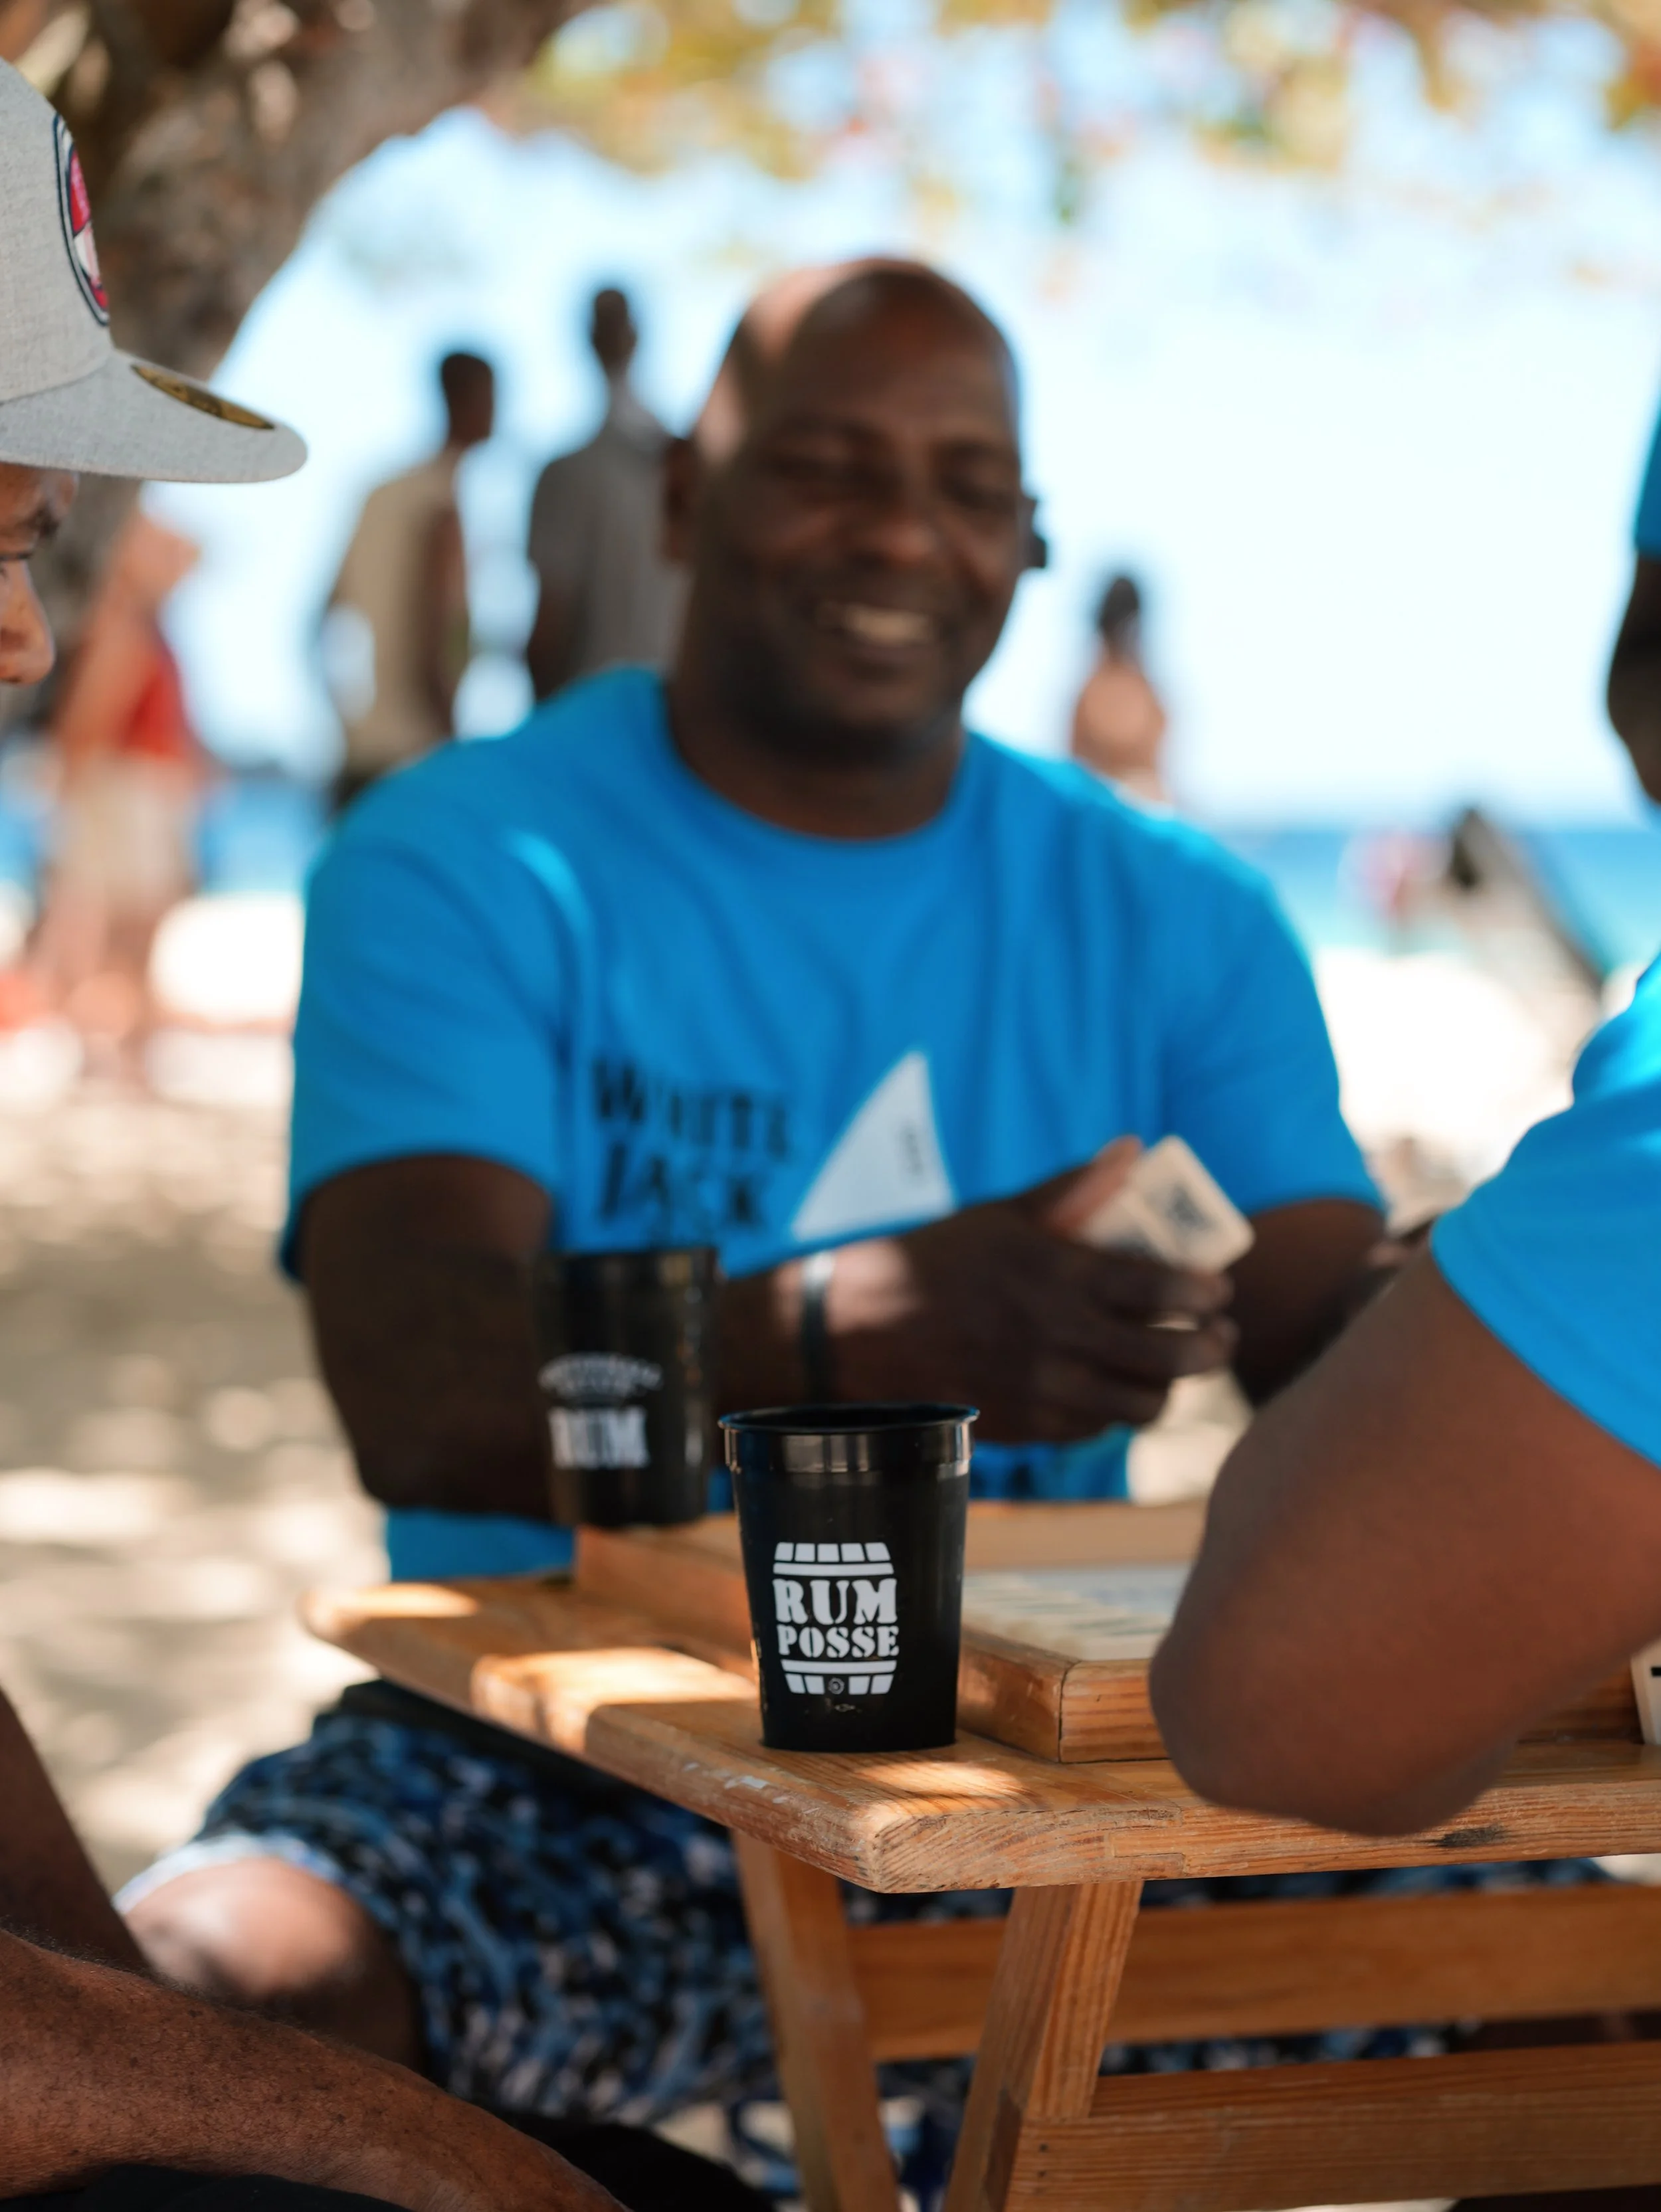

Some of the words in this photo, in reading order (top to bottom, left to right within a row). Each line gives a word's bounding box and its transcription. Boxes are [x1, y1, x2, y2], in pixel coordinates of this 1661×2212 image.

[549, 1407, 648, 1467] RUM
[772, 1578, 898, 1625] RUM
[777, 1625, 900, 1658] POSSE
